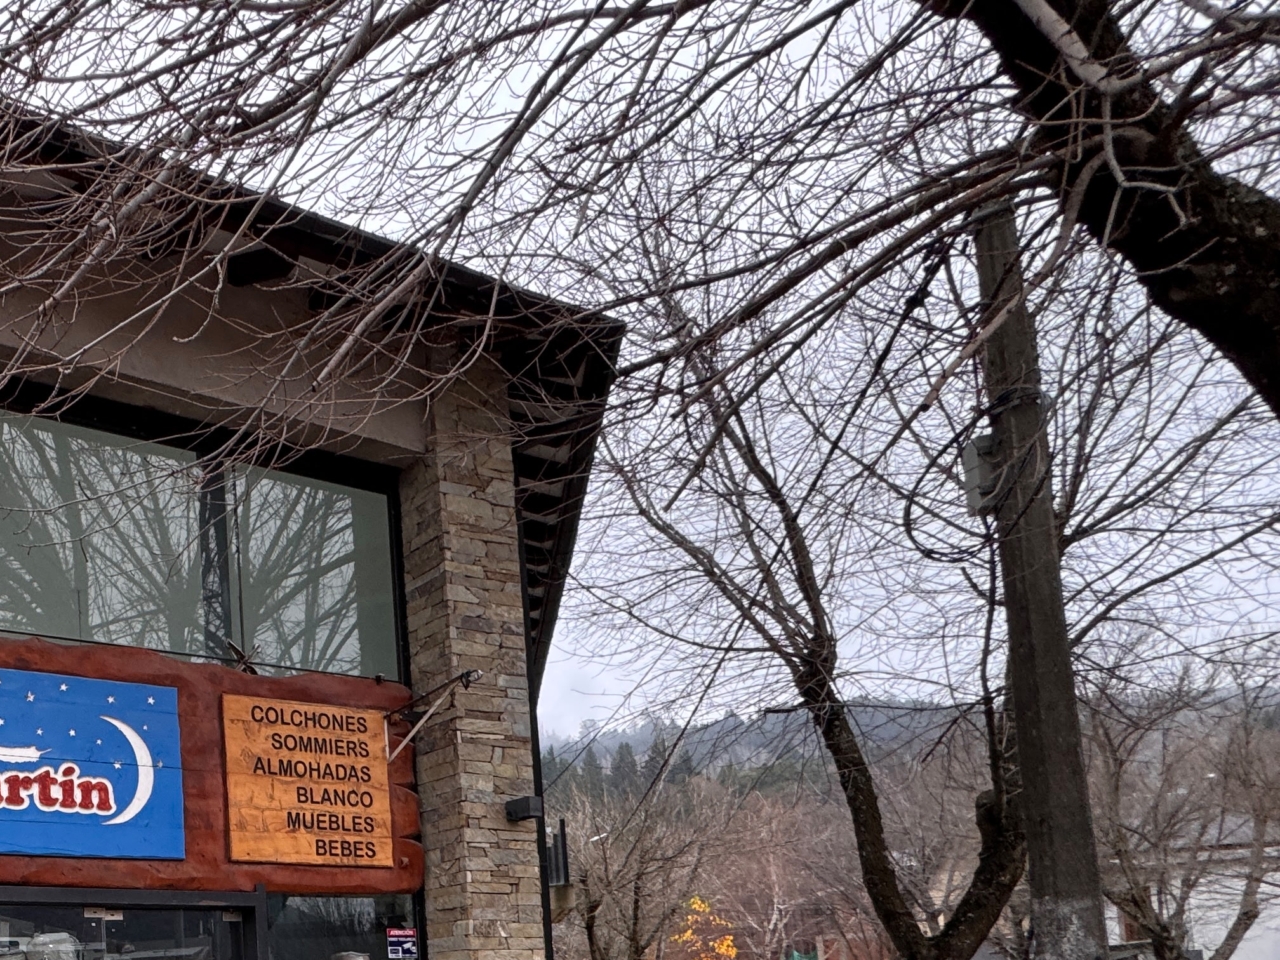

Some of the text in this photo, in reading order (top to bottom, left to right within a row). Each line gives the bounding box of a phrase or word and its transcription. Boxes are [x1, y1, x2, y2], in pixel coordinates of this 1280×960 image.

[251, 705, 368, 734] COLCHONES
[271, 733, 370, 758] SOMMIERS
[253, 757, 371, 782] ALMOHADAS
[296, 786, 373, 808] BLANCO
[287, 811, 375, 833] MUEBLES
[315, 839, 376, 859] BEBES
